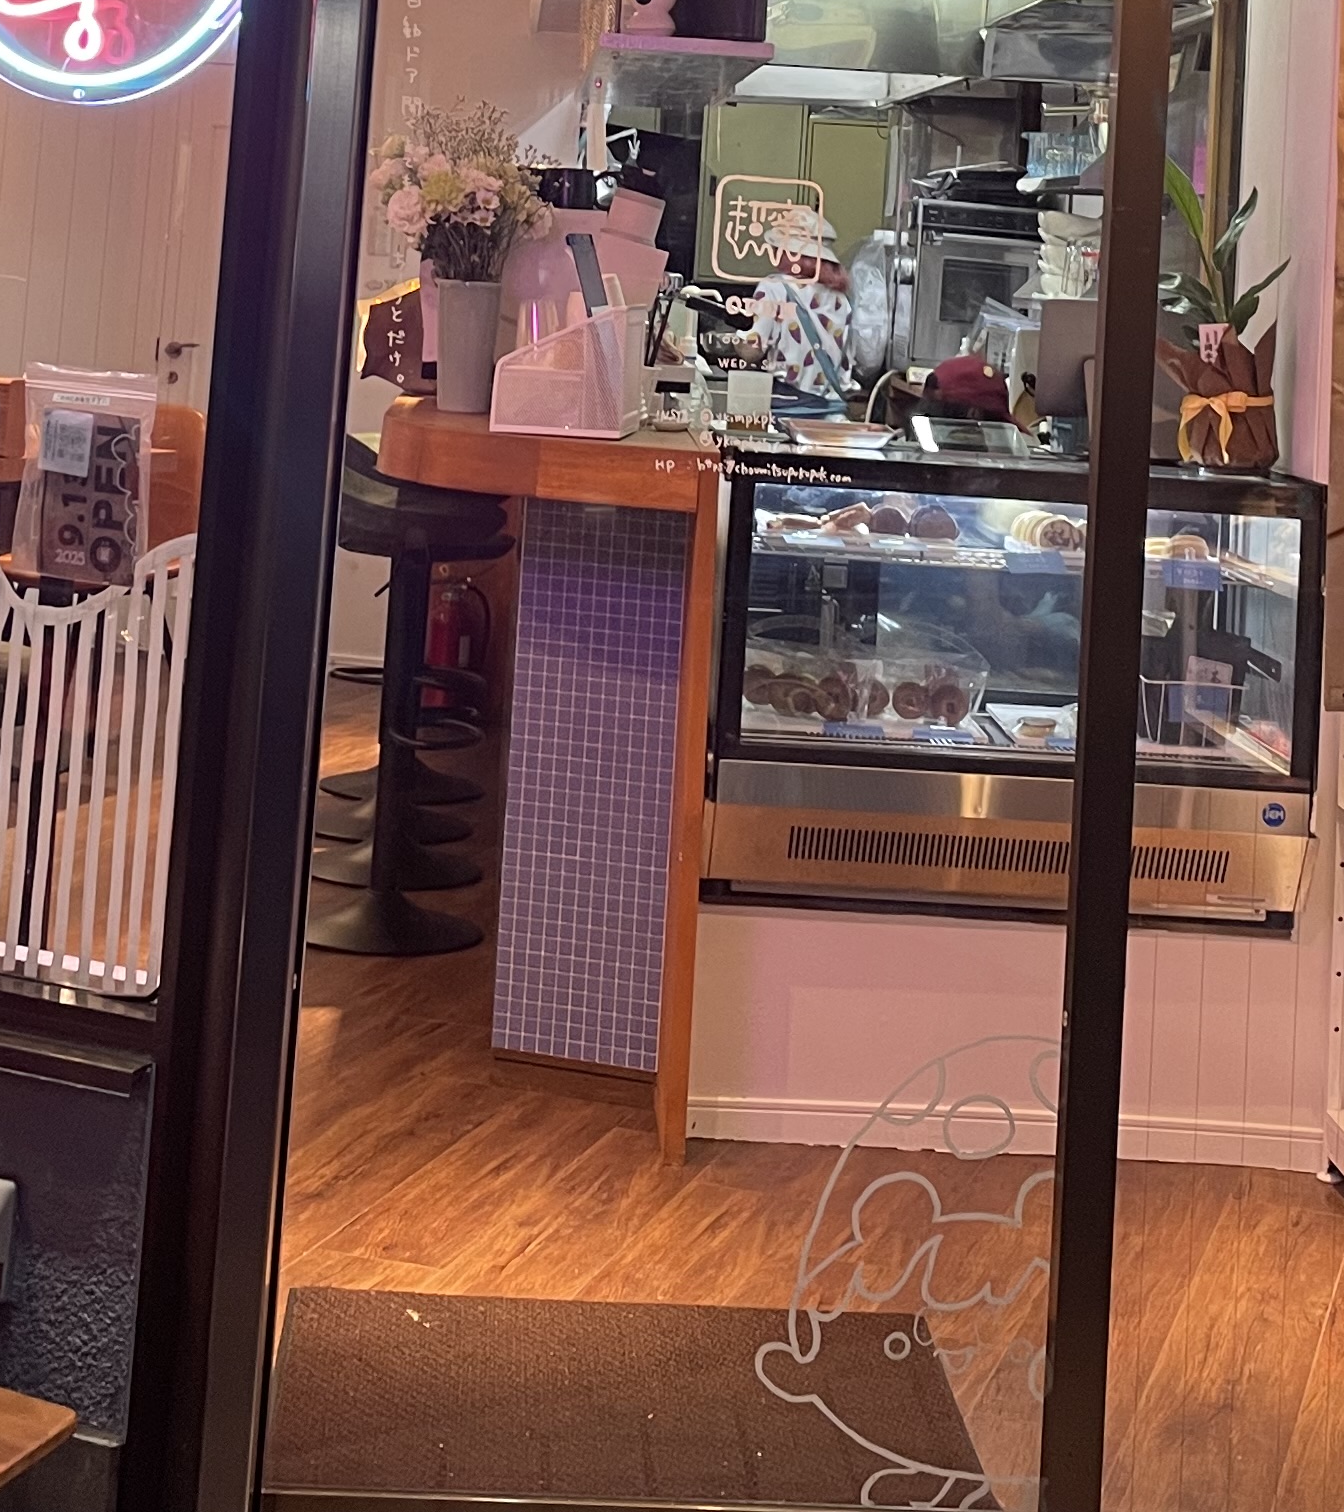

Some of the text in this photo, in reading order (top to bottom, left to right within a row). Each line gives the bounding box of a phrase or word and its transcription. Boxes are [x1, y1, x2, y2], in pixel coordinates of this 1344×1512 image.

[717, 357, 747, 370] WED
[655, 459, 675, 474] HP
[90, 424, 126, 573] OPEN
[54, 549, 86, 566] 2025
